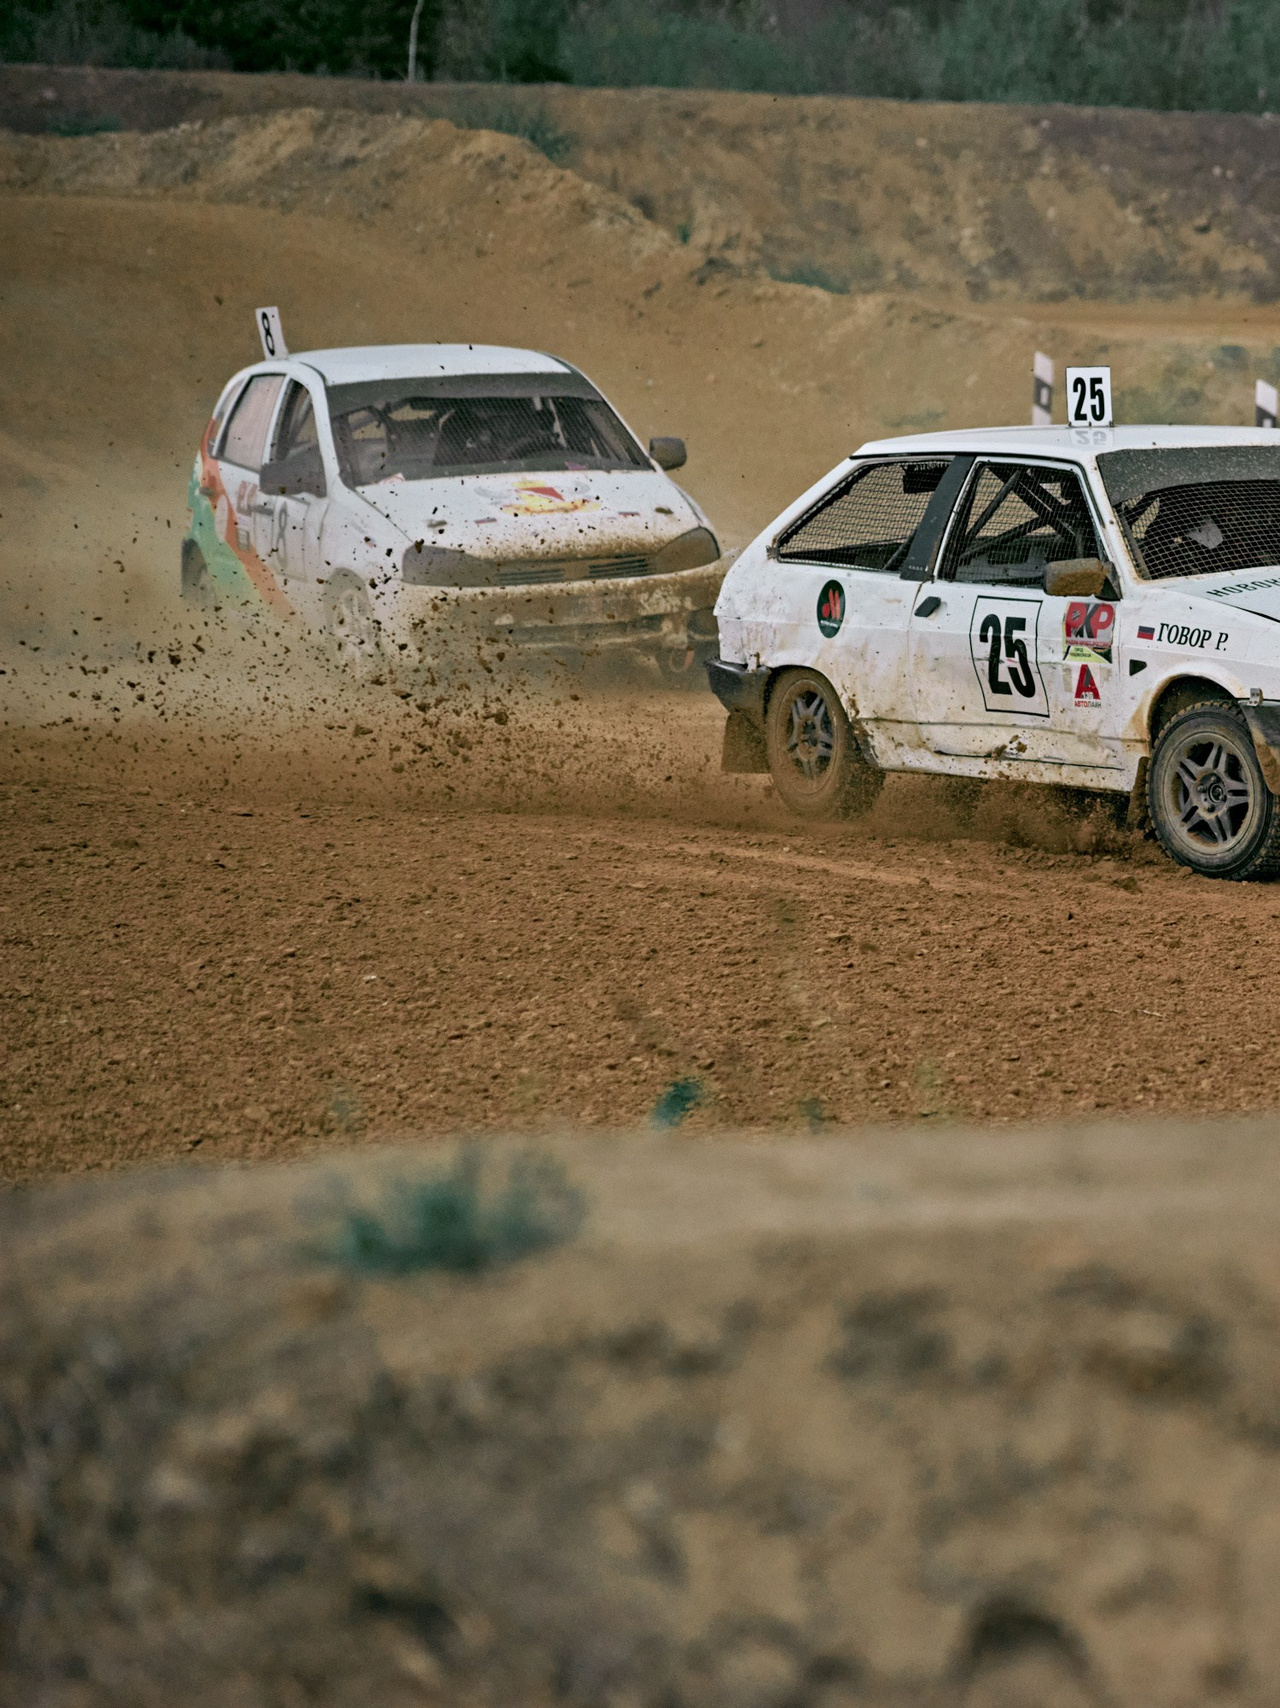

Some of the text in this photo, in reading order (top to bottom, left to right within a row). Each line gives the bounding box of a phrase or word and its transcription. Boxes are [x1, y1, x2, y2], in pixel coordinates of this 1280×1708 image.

[261, 311, 275, 356] 8
[1073, 377, 1105, 421] 25
[979, 613, 1036, 698] 25
[1157, 622, 1229, 652] ГОВОР Р.
